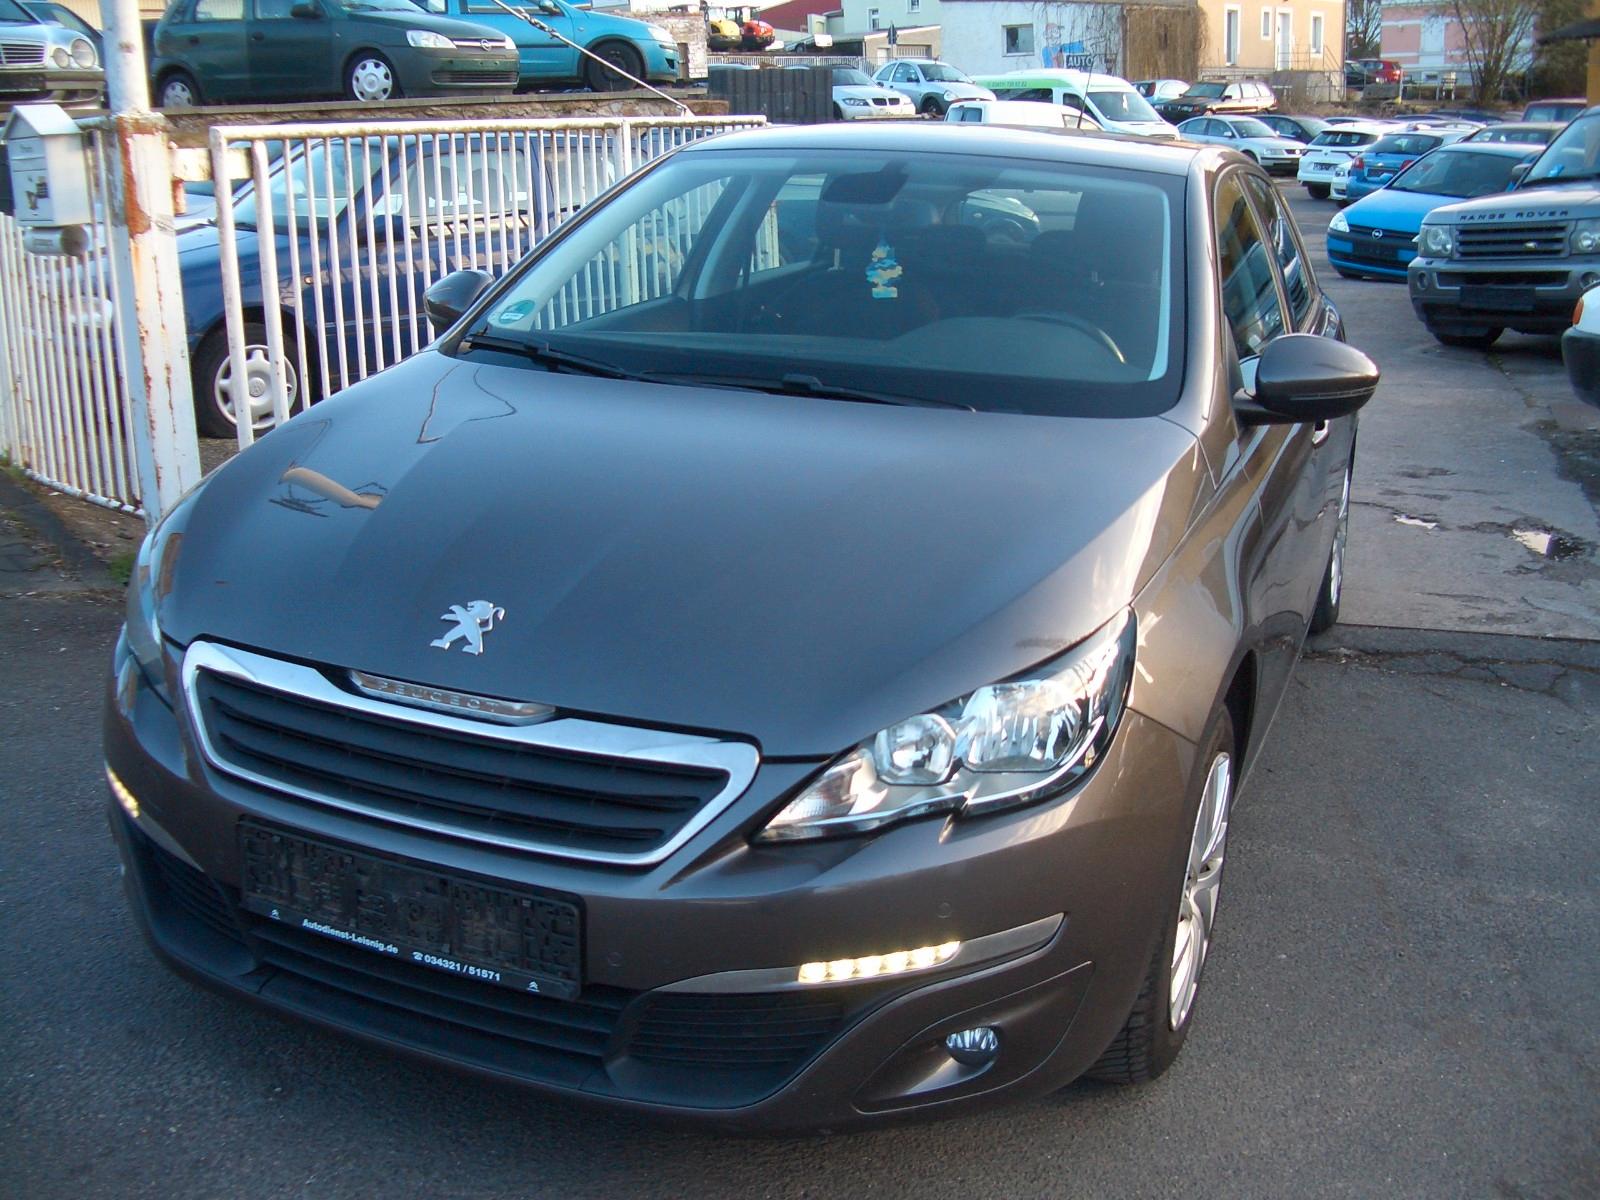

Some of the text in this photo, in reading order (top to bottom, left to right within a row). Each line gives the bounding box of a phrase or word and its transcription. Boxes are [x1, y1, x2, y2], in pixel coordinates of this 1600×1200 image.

[1067, 55, 1093, 67] AUTO
[1460, 209, 1569, 222] RANGE ROVER
[424, 954, 461, 972] 034321
[468, 966, 500, 981] 51571
